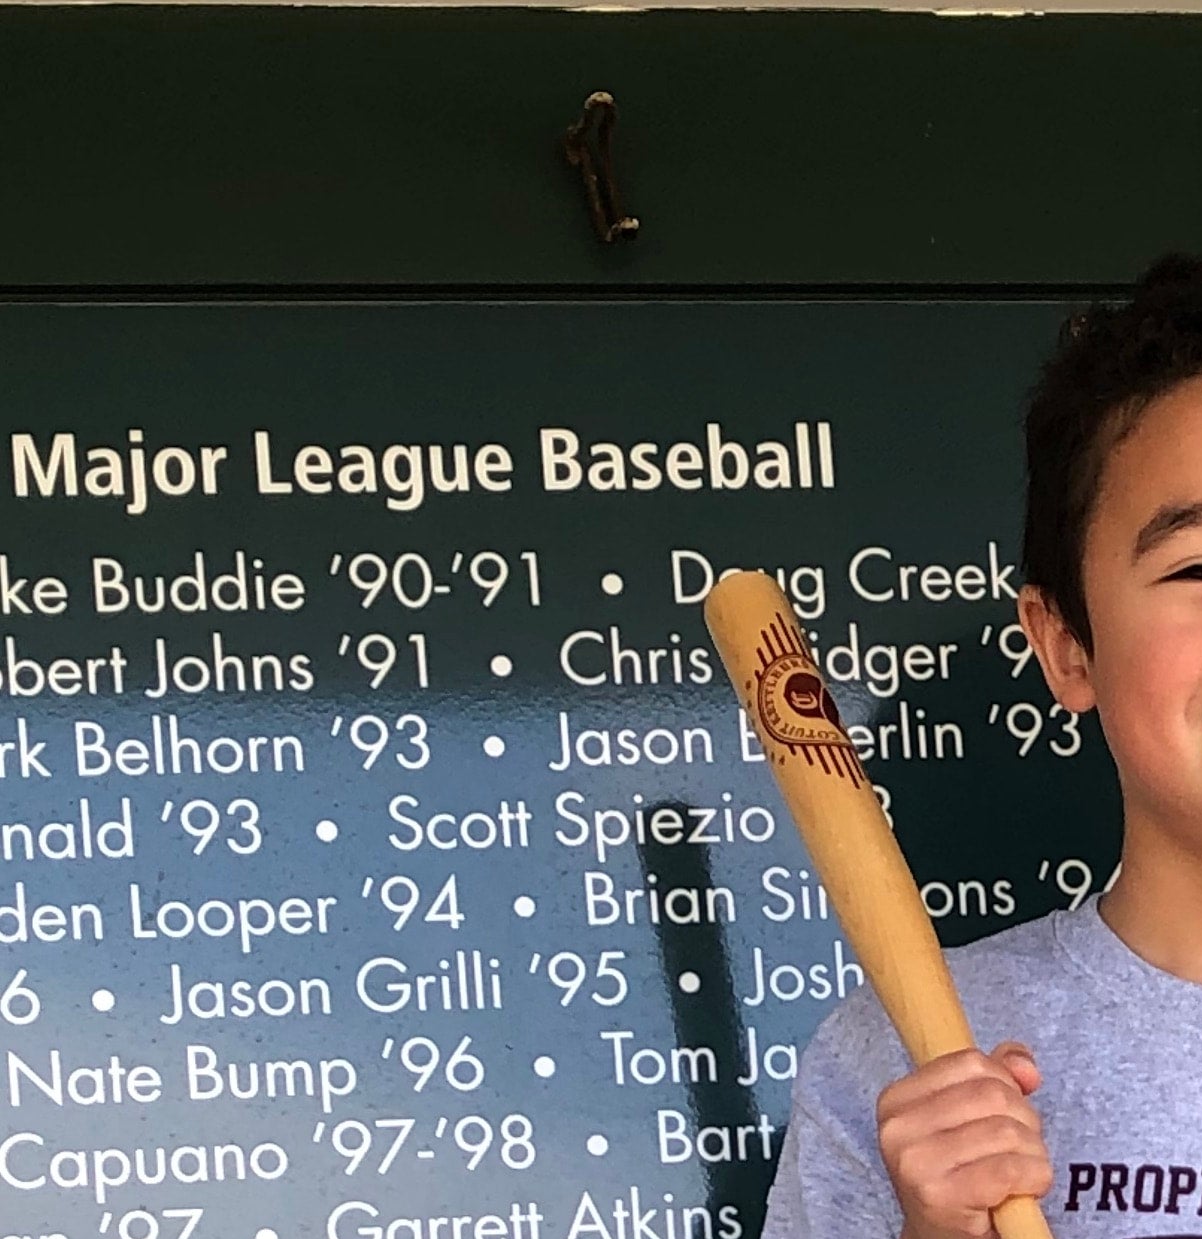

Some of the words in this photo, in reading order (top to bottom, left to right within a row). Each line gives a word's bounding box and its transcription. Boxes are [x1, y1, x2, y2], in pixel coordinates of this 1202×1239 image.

[11, 429, 228, 515] Major
[254, 430, 514, 512] League
[539, 421, 835, 492] Baseball
[0, 554, 69, 615] ke
[92, 550, 306, 614] Buddie
[329, 551, 541, 610] '90-'91
[670, 549, 826, 620] Dg
[848, 542, 1019, 603] Creek
[0, 633, 128, 697] bert
[143, 631, 315, 699] Johns
[338, 633, 429, 690] '91
[559, 625, 713, 687] Chris
[799, 622, 959, 698] idger
[74, 713, 305, 778] Belhorn
[330, 713, 431, 771] '93
[548, 711, 714, 772] Jason
[988, 702, 1083, 758] '93
[1, 797, 135, 861] nald
[160, 798, 262, 856] '93
[388, 794, 533, 852] Scott
[554, 790, 776, 863] Spiezio
[0, 881, 104, 944] den
[129, 883, 338, 954] Looper
[361, 873, 466, 932] '94
[584, 873, 737, 926] Brian
[761, 866, 1016, 922] Sions
[159, 963, 332, 1025] Jason
[355, 949, 502, 1014] Grilli
[528, 950, 628, 1007] '95
[742, 939, 865, 1007] Josh
[7, 1049, 162, 1107] Nate
[186, 1045, 357, 1114] Bump
[381, 1035, 485, 1093] '96
[599, 1030, 718, 1086] Tom
[0, 1132, 289, 1204] Capuano
[312, 1113, 536, 1176] '97-'98
[657, 1109, 775, 1164] Bart
